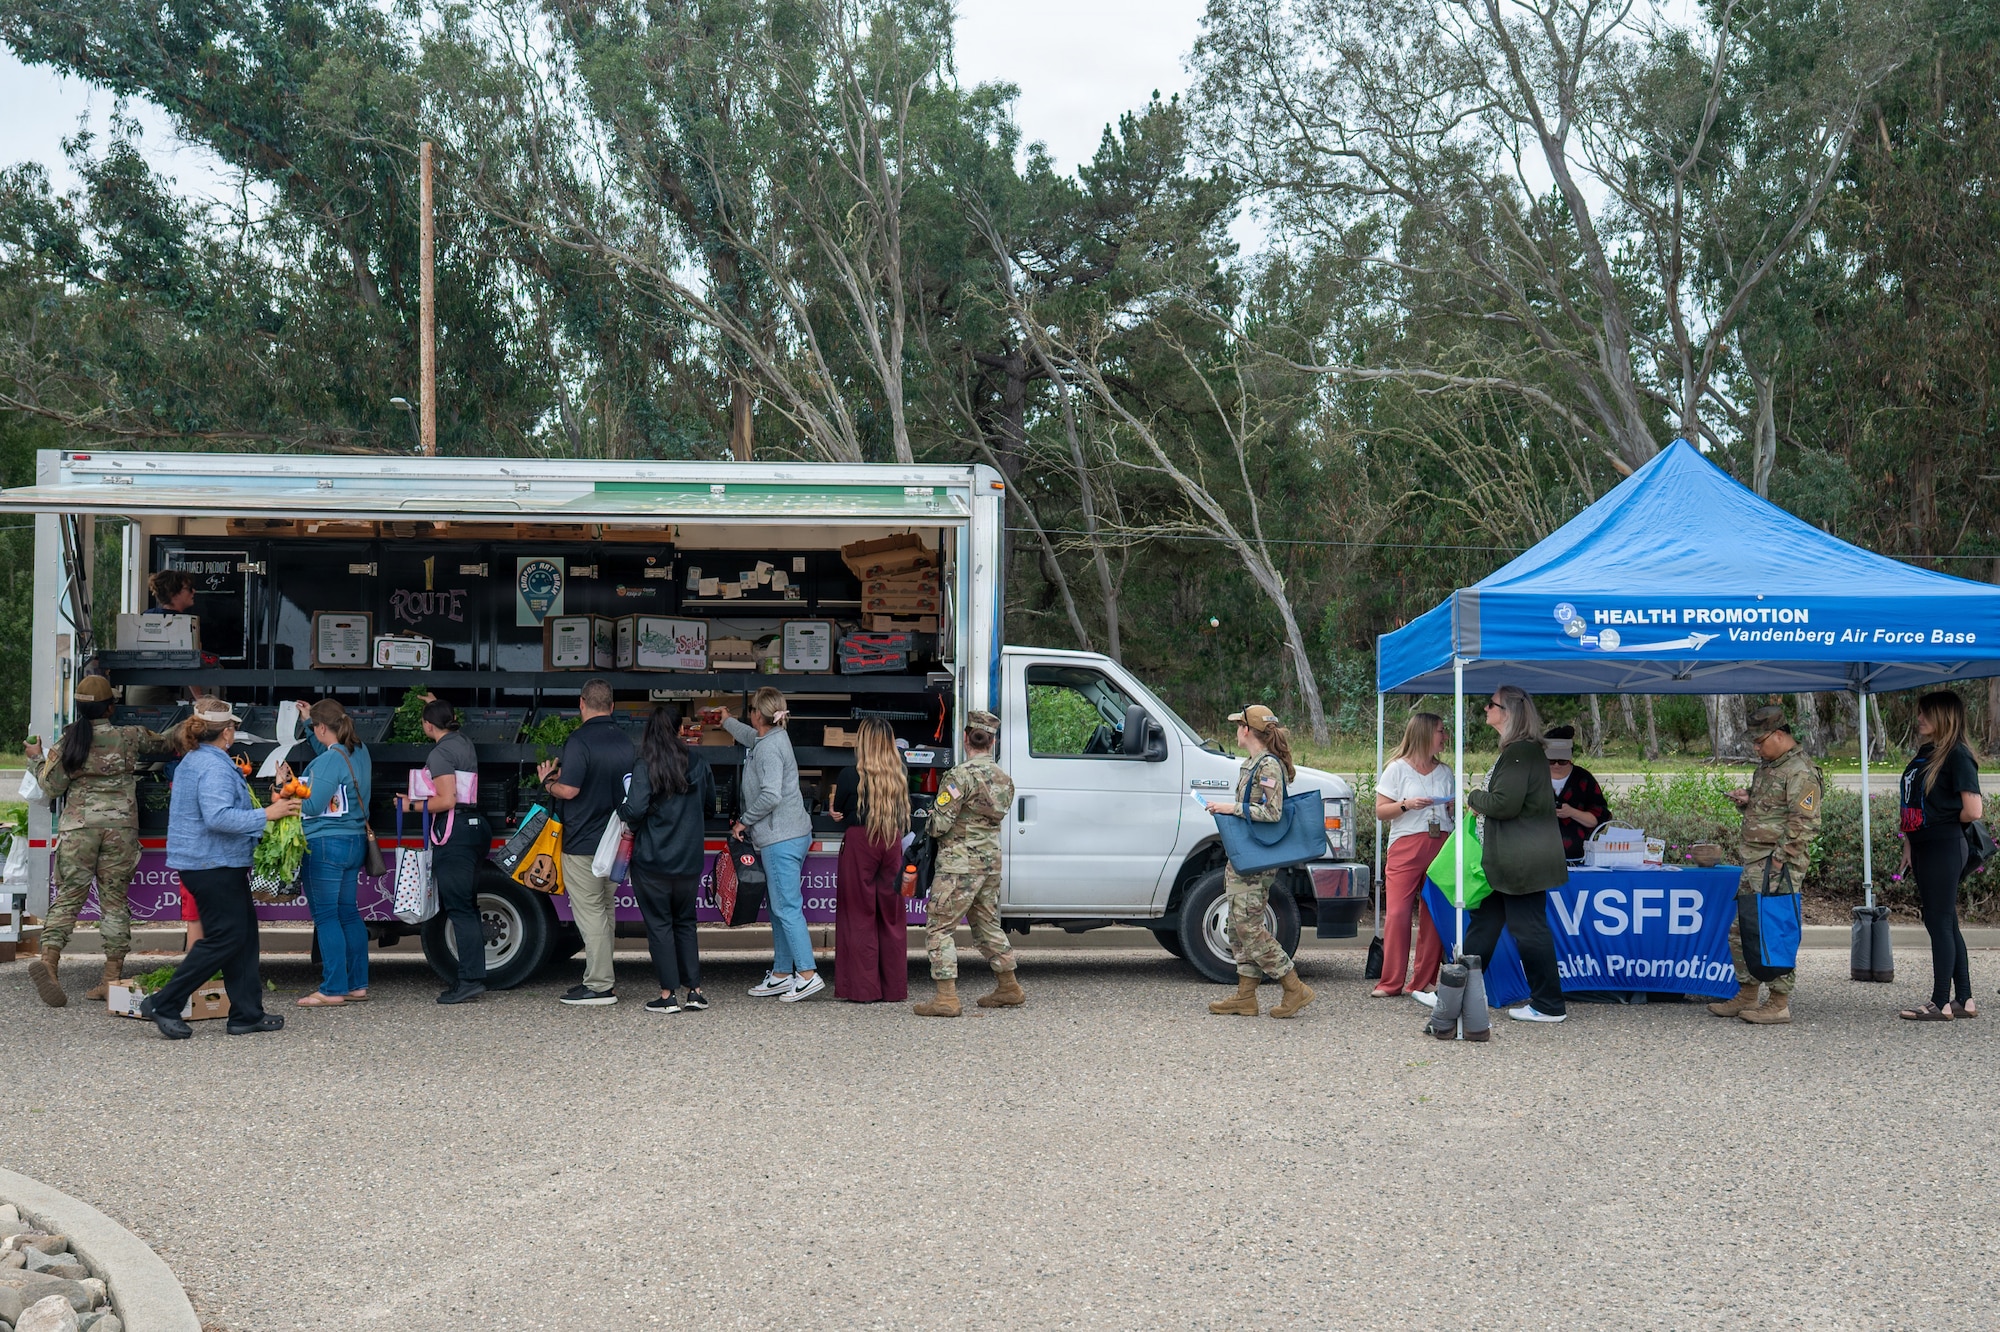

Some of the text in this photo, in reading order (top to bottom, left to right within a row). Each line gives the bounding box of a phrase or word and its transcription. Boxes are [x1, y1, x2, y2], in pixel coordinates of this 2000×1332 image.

[175, 561, 231, 574] FEATURED PRODUCE
[539, 562, 555, 572] ART
[551, 573, 561, 596] WALK
[389, 588, 468, 625] ROUTE
[1594, 608, 1809, 624] HEALTH PROMOTION
[678, 635, 705, 652] Select
[1728, 627, 1976, 646] Vandenberg Air Force Base
[1549, 888, 1704, 936] VSFB
[1557, 953, 1736, 984] alth Promotion
